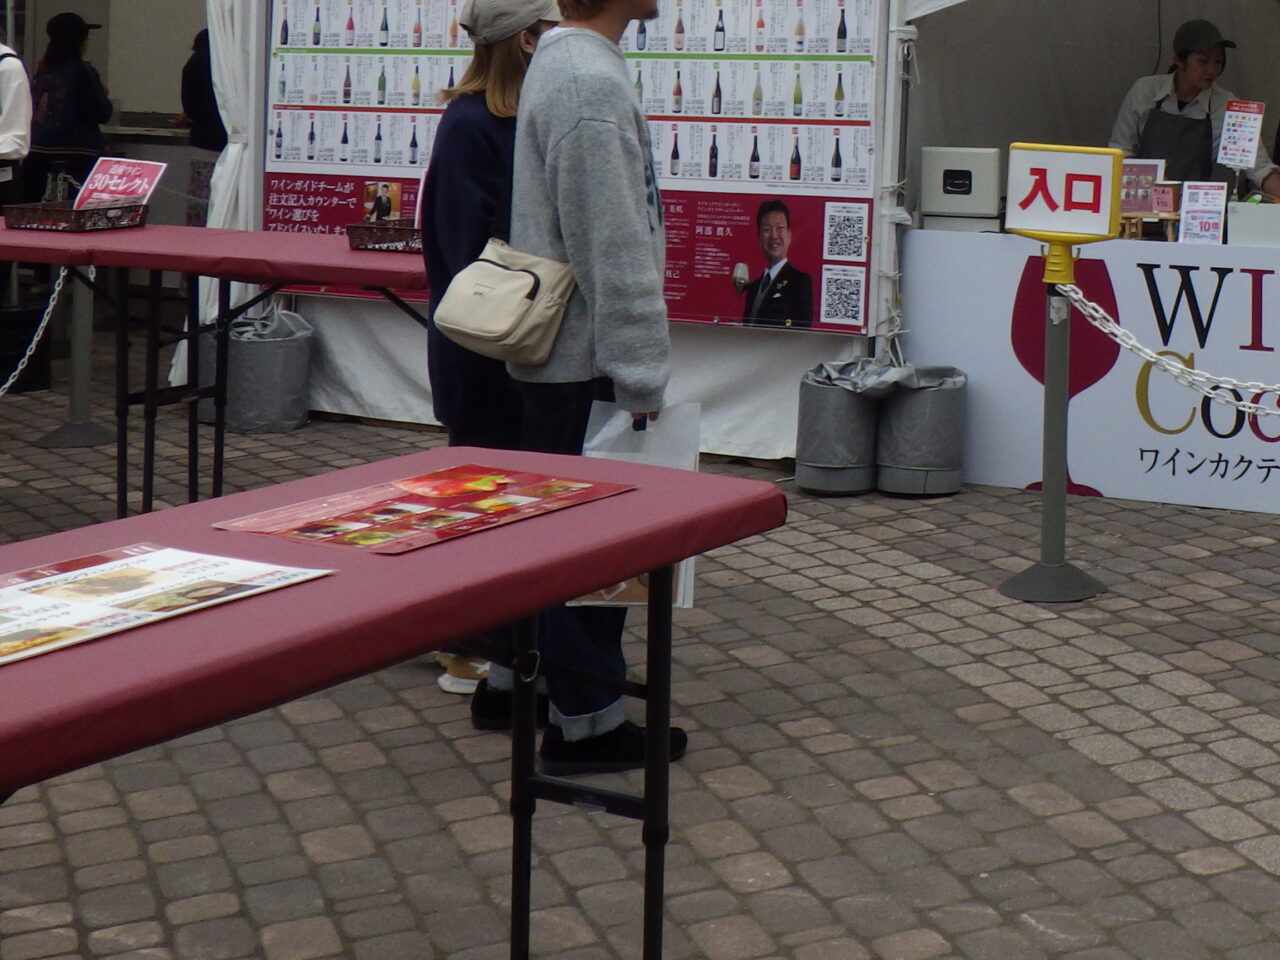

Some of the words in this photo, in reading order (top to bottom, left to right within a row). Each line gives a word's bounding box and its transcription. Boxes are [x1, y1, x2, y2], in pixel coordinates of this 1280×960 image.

[89, 173, 149, 193] 30セレクト
[271, 179, 354, 194] ワインガイドチームが
[1018, 167, 1102, 214] 入口
[268, 193, 357, 209] 注文記入カウンターで
[268, 208, 320, 222] ワイン選びを
